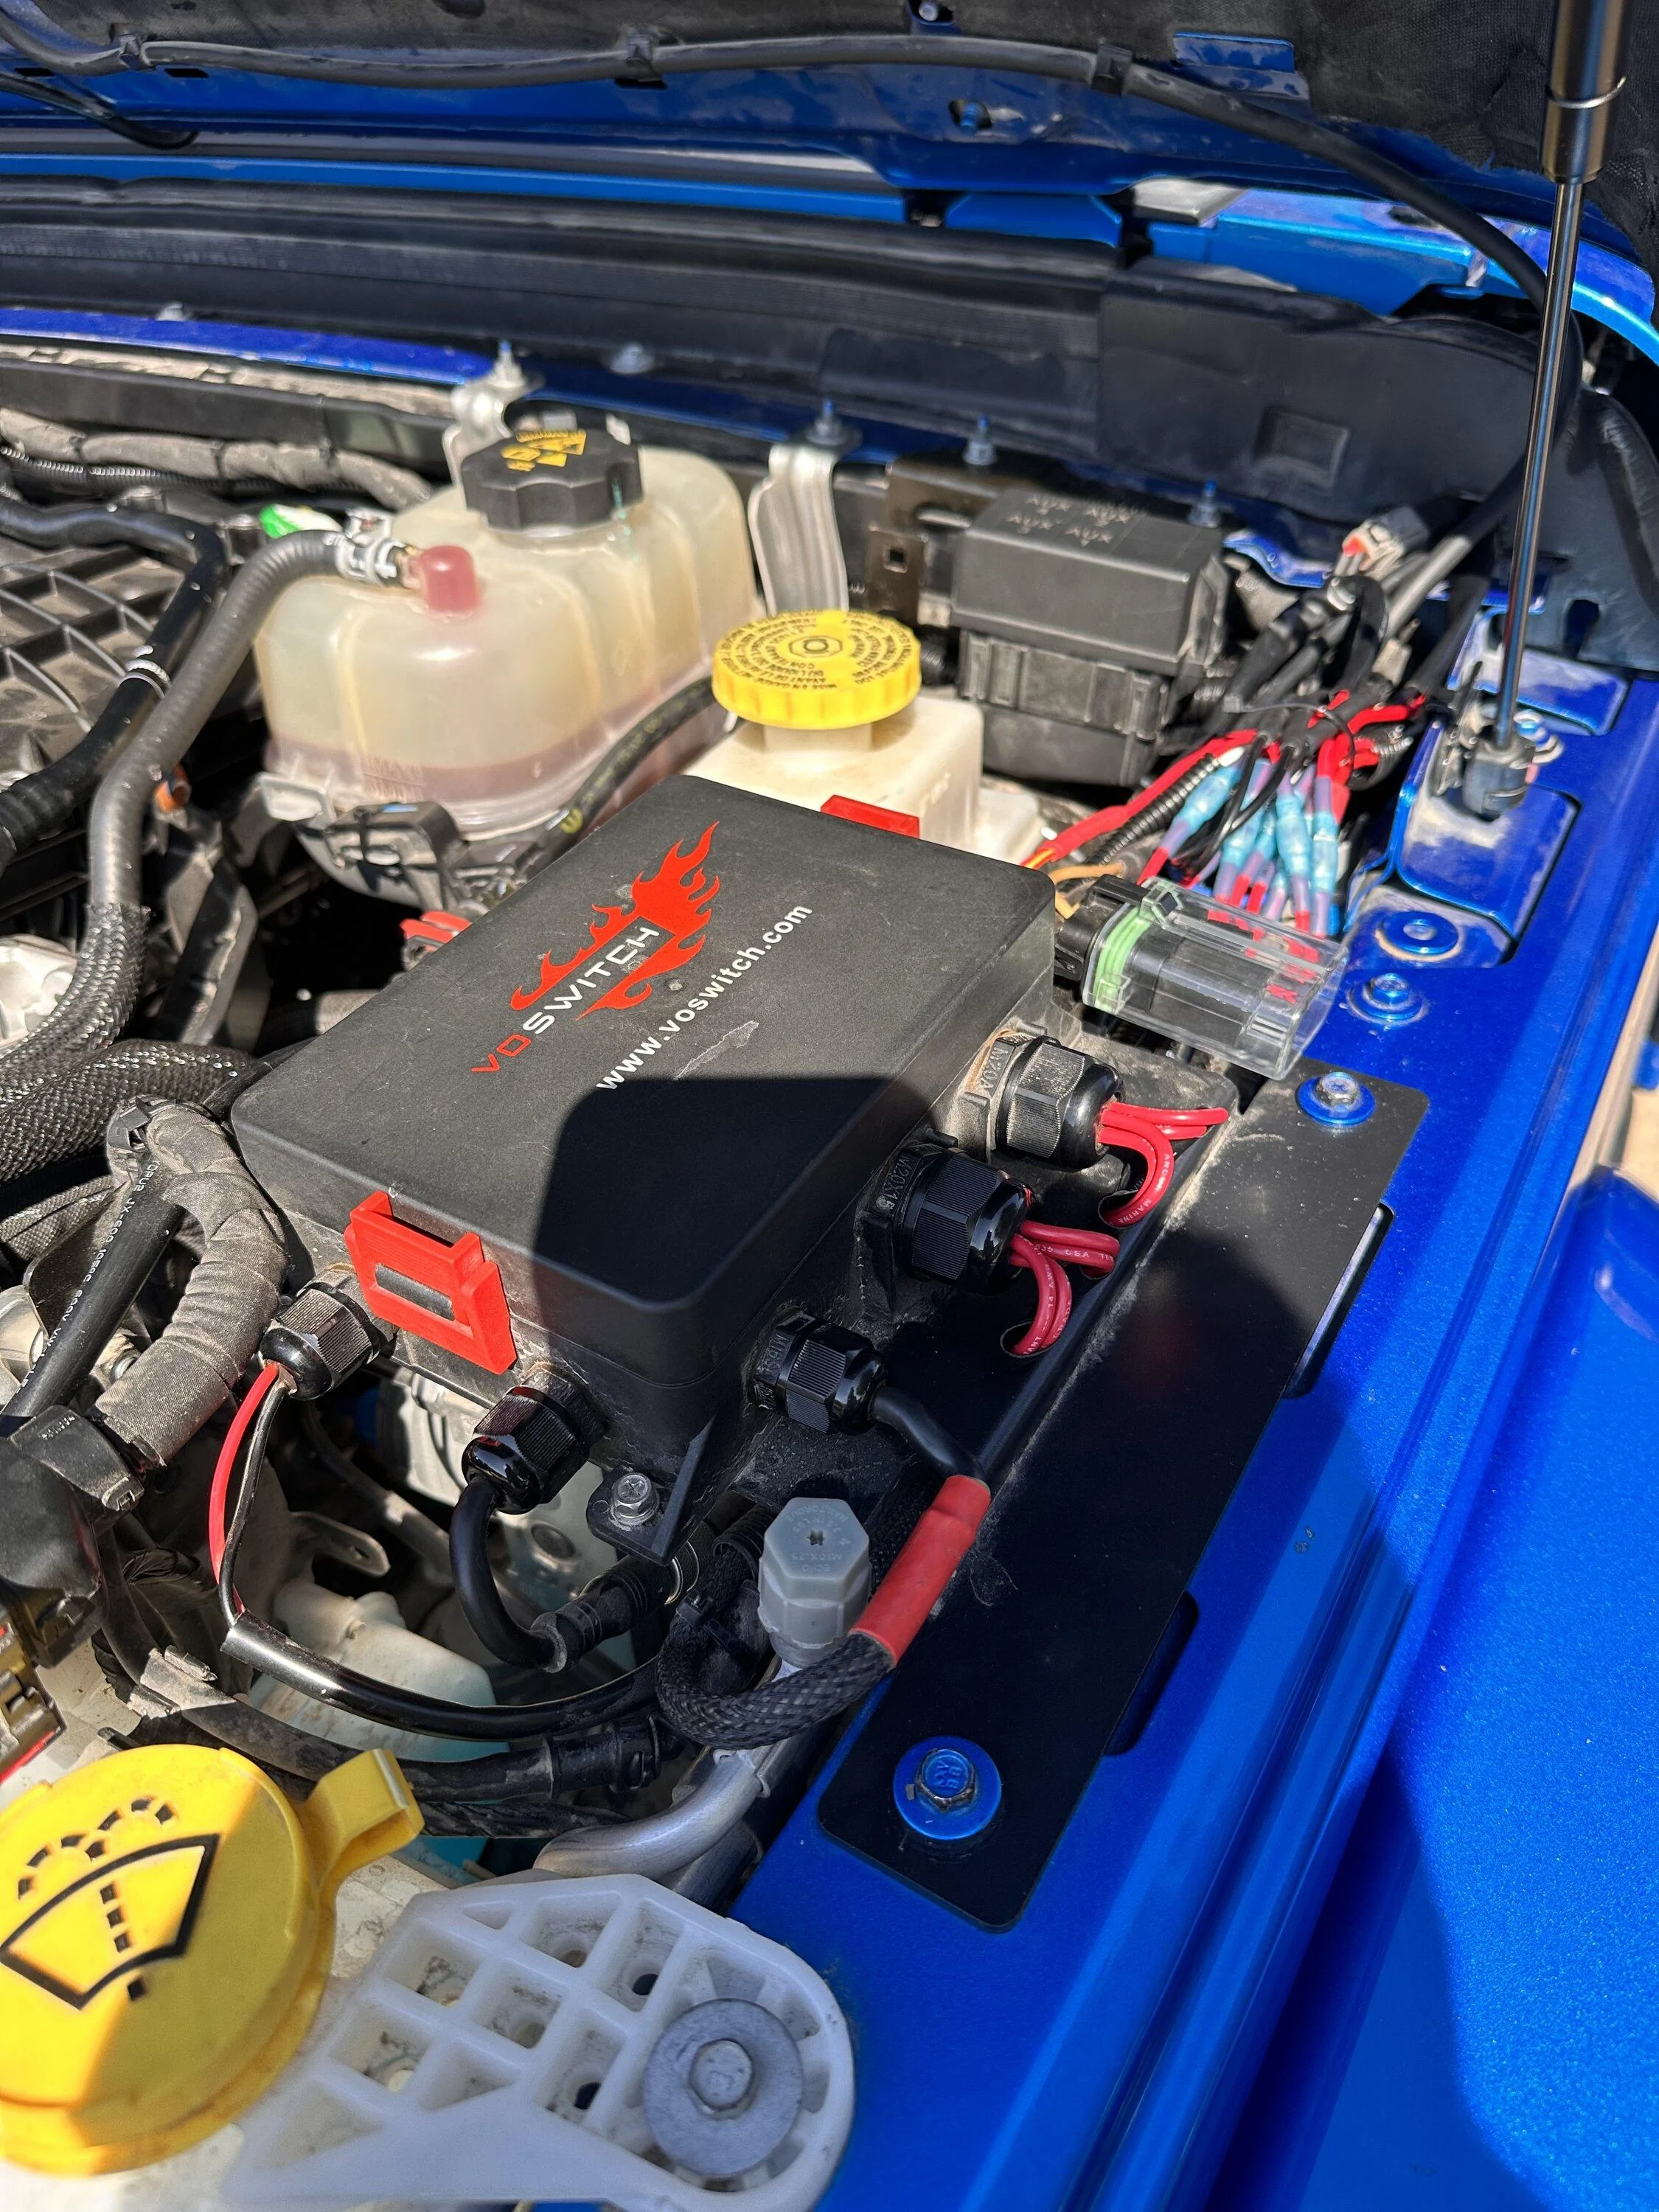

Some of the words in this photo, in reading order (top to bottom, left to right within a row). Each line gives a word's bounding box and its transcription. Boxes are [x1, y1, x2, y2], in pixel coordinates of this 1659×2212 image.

[597, 905, 813, 1090] www.voswitch.com
[106, 1198, 135, 1243] JX-600
[1118, 1198, 1152, 1224] MARINE
[1065, 1249, 1089, 1258] CSA
[785, 1504, 827, 1523] TORQUE
